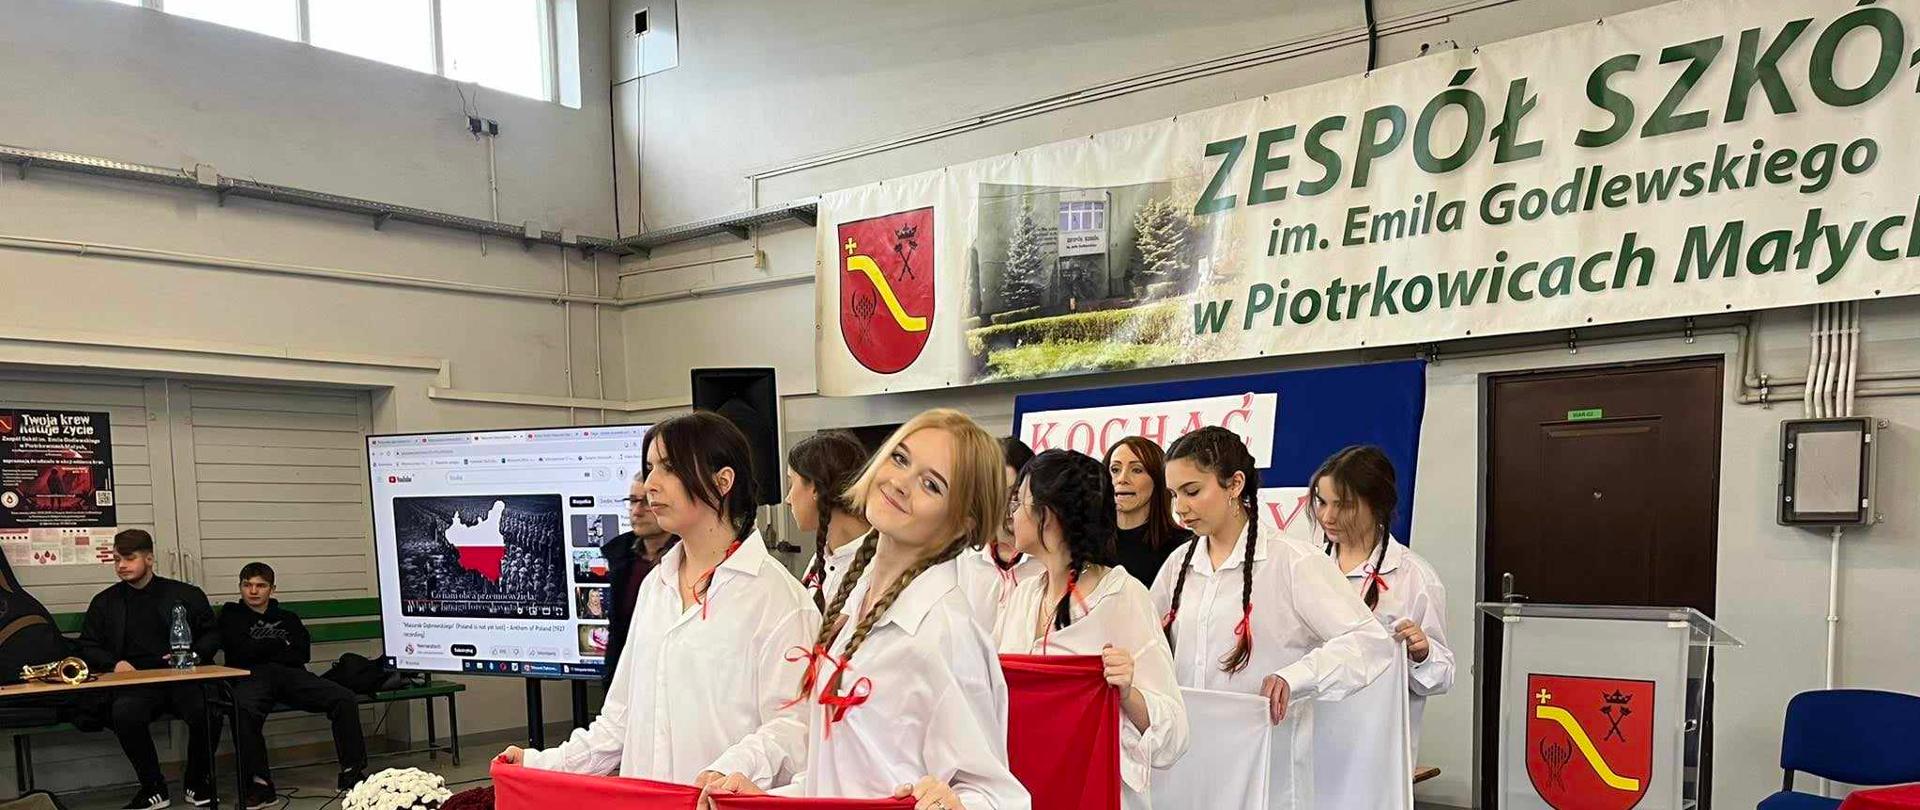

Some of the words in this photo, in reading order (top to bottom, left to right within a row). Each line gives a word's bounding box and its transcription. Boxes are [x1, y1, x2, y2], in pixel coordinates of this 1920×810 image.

[1193, 67, 1544, 217] ZESPÓŁ
[1574, 0, 1920, 148] SZKÓ
[1267, 217, 1329, 257] im.
[1342, 191, 1466, 247] Emila
[1479, 137, 1879, 226] Godlewskiego
[1193, 299, 1233, 335] w
[1243, 232, 1657, 331] Piotrkowicach
[22, 413, 57, 427] Twoja
[60, 413, 90, 426] krew
